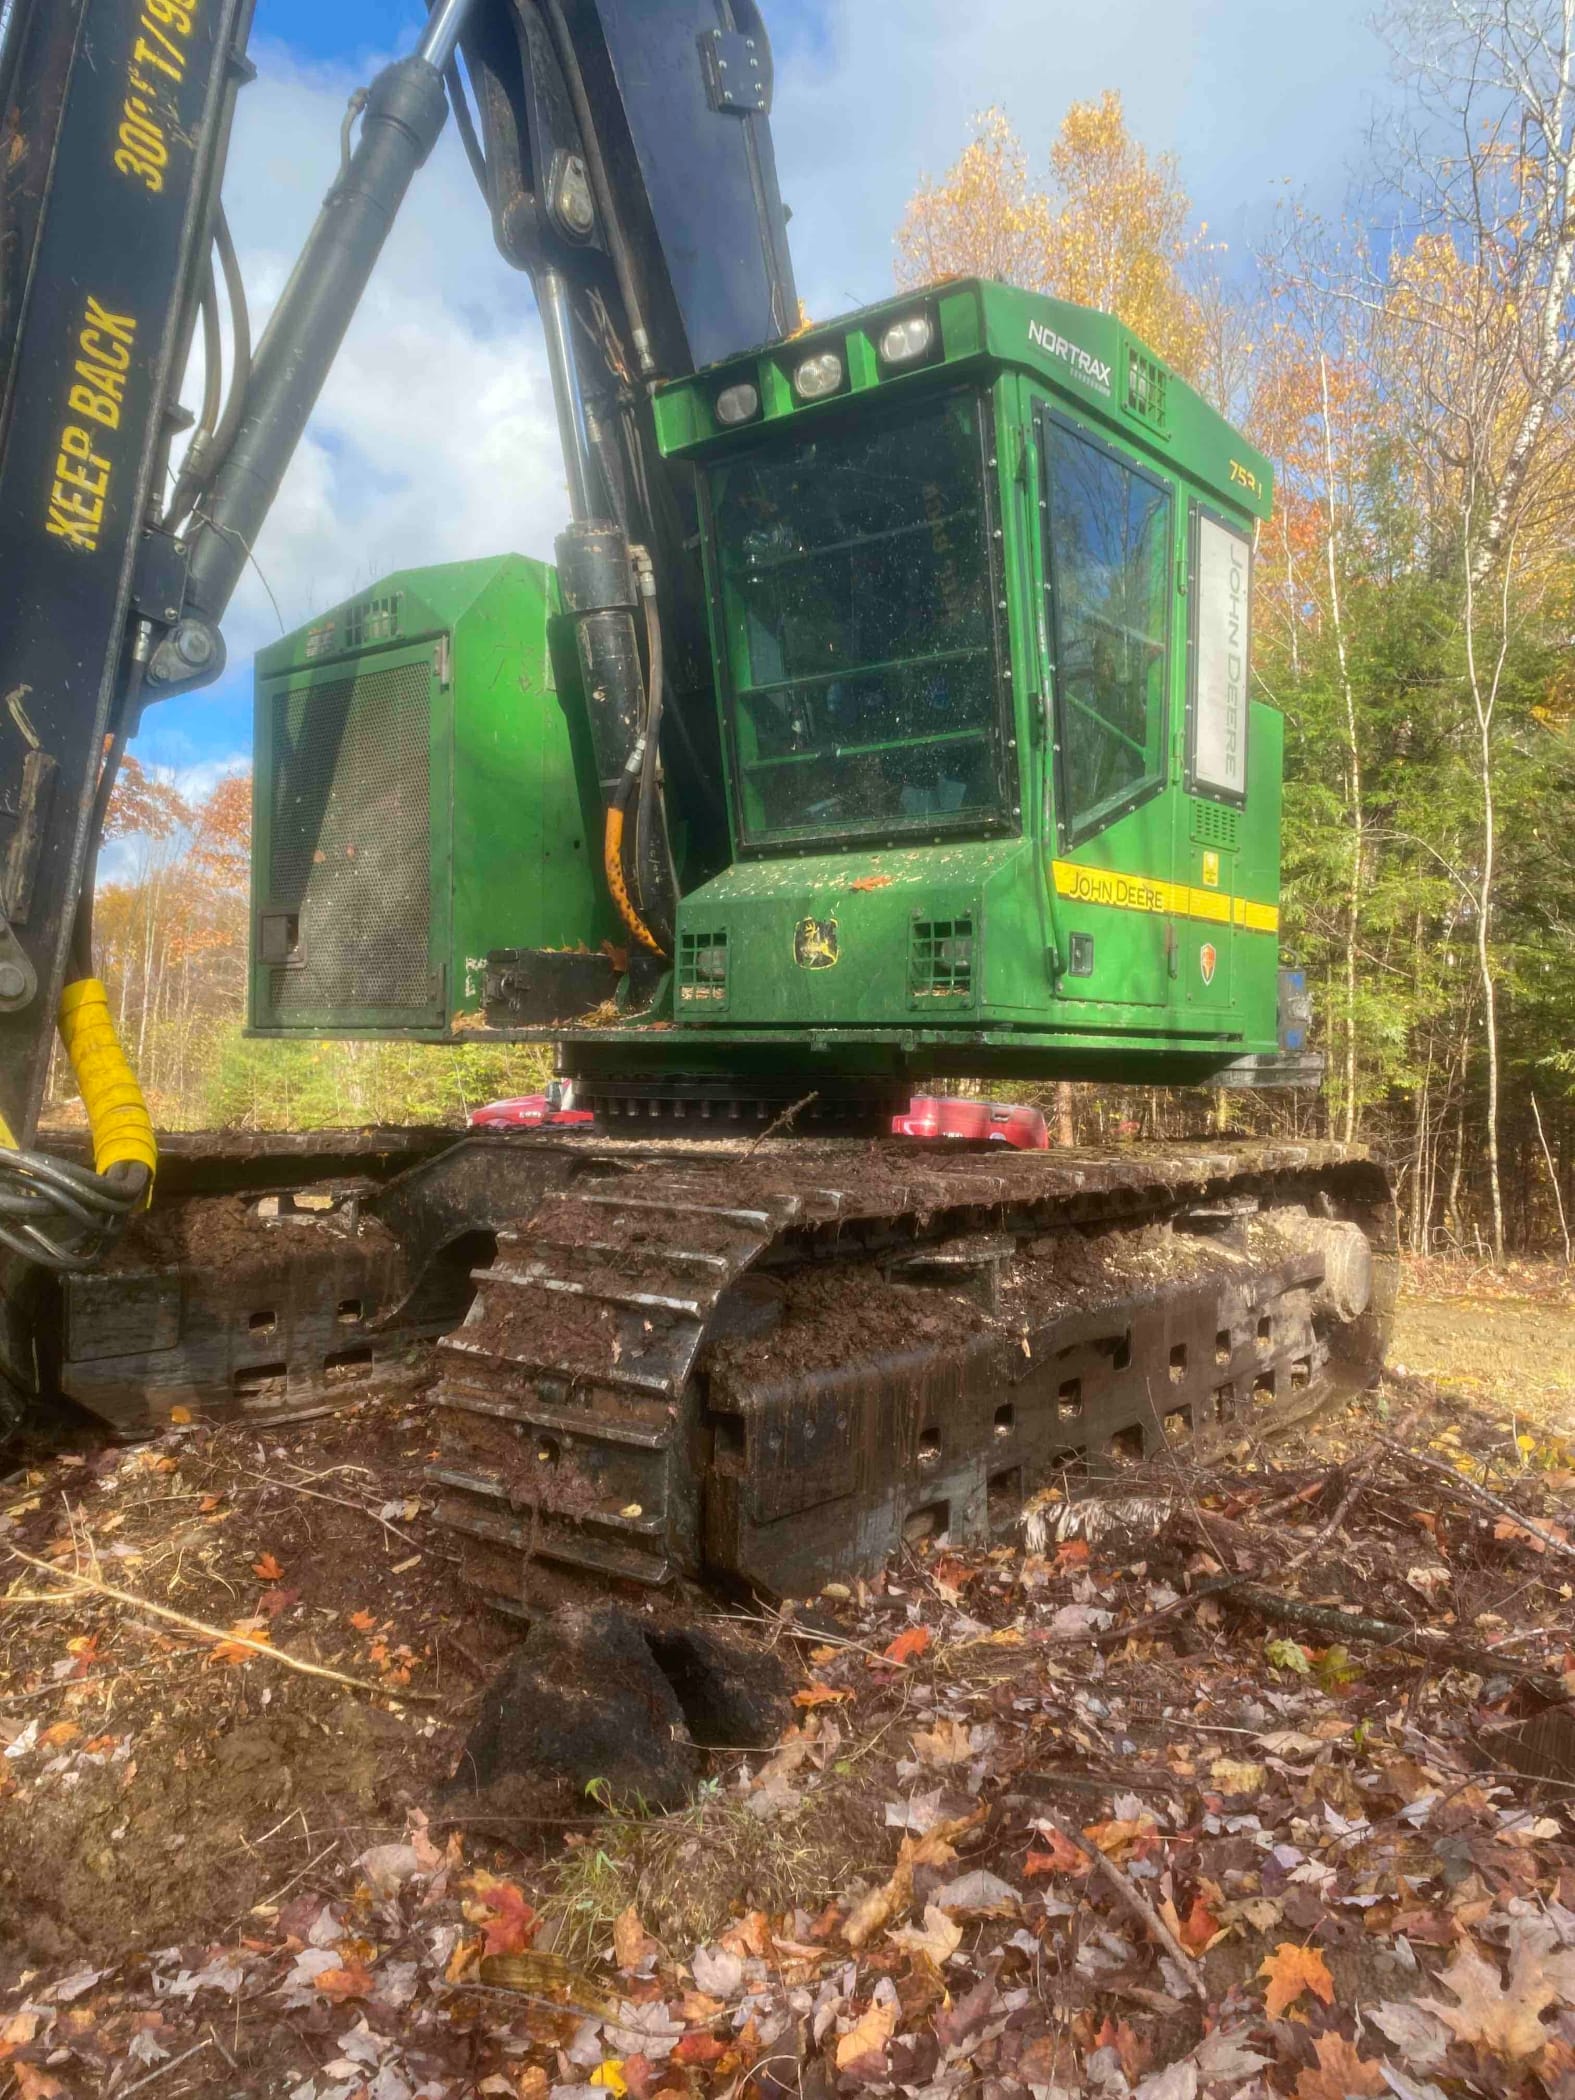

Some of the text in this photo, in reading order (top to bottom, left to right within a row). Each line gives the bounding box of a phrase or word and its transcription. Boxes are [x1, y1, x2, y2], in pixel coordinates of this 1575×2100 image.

[46, 295, 138, 551] KEEP BACK
[1028, 319, 1112, 387] NORTRAX
[1224, 543, 1243, 778] JOHN DEERE
[1069, 872, 1163, 910] JOHN DEERE
